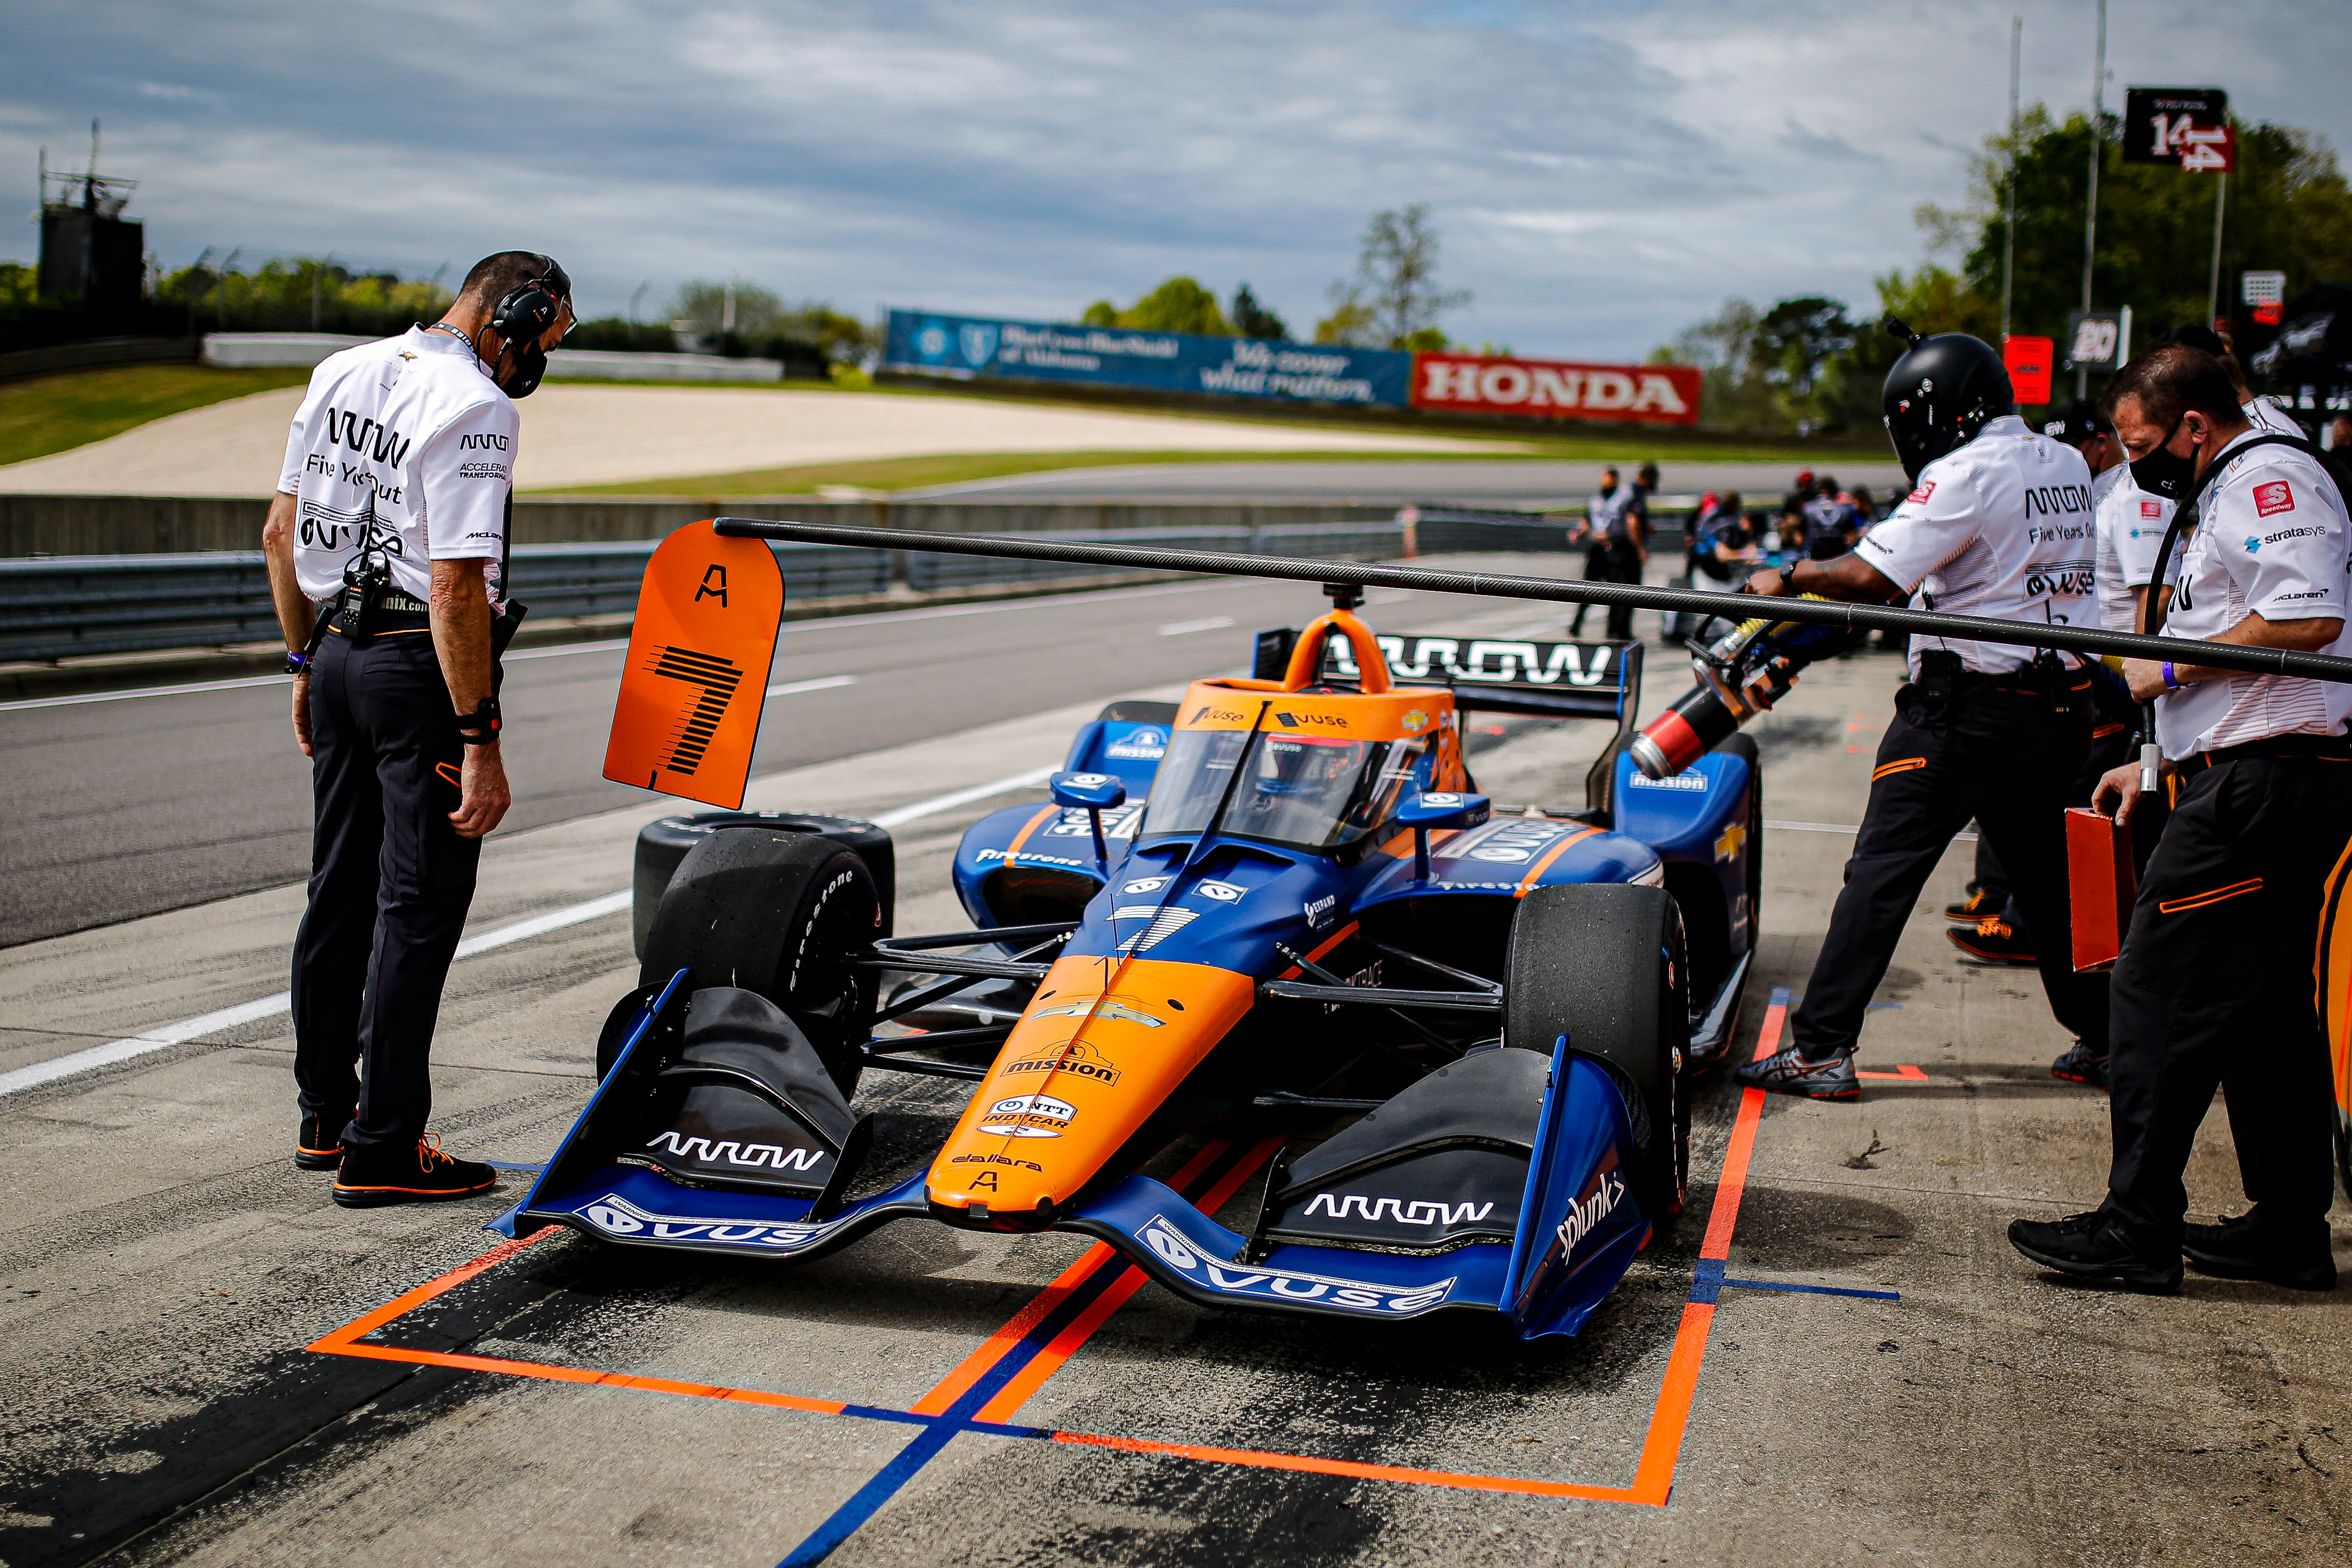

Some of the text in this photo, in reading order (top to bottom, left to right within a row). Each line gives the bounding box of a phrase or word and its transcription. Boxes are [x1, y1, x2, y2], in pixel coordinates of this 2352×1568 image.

[1423, 361, 1688, 415] HONDA
[2261, 503, 2292, 515] Speedway
[2029, 526, 2055, 545] Five
[2055, 523, 2084, 541] Years
[2264, 525, 2326, 545] stratasys
[642, 644, 745, 776] 7
[976, 848, 1083, 866] Firestone
[1105, 904, 1202, 952] 7
[1027, 1102, 1069, 1115] NTT
[647, 1131, 824, 1171] ARROW
[951, 1154, 1043, 1173] dallara
[614, 1200, 651, 1220] WARNING:
[1303, 1194, 1495, 1225] ARROW
[1163, 1223, 1200, 1254] WARNING:
[1200, 1252, 1214, 1262] This
